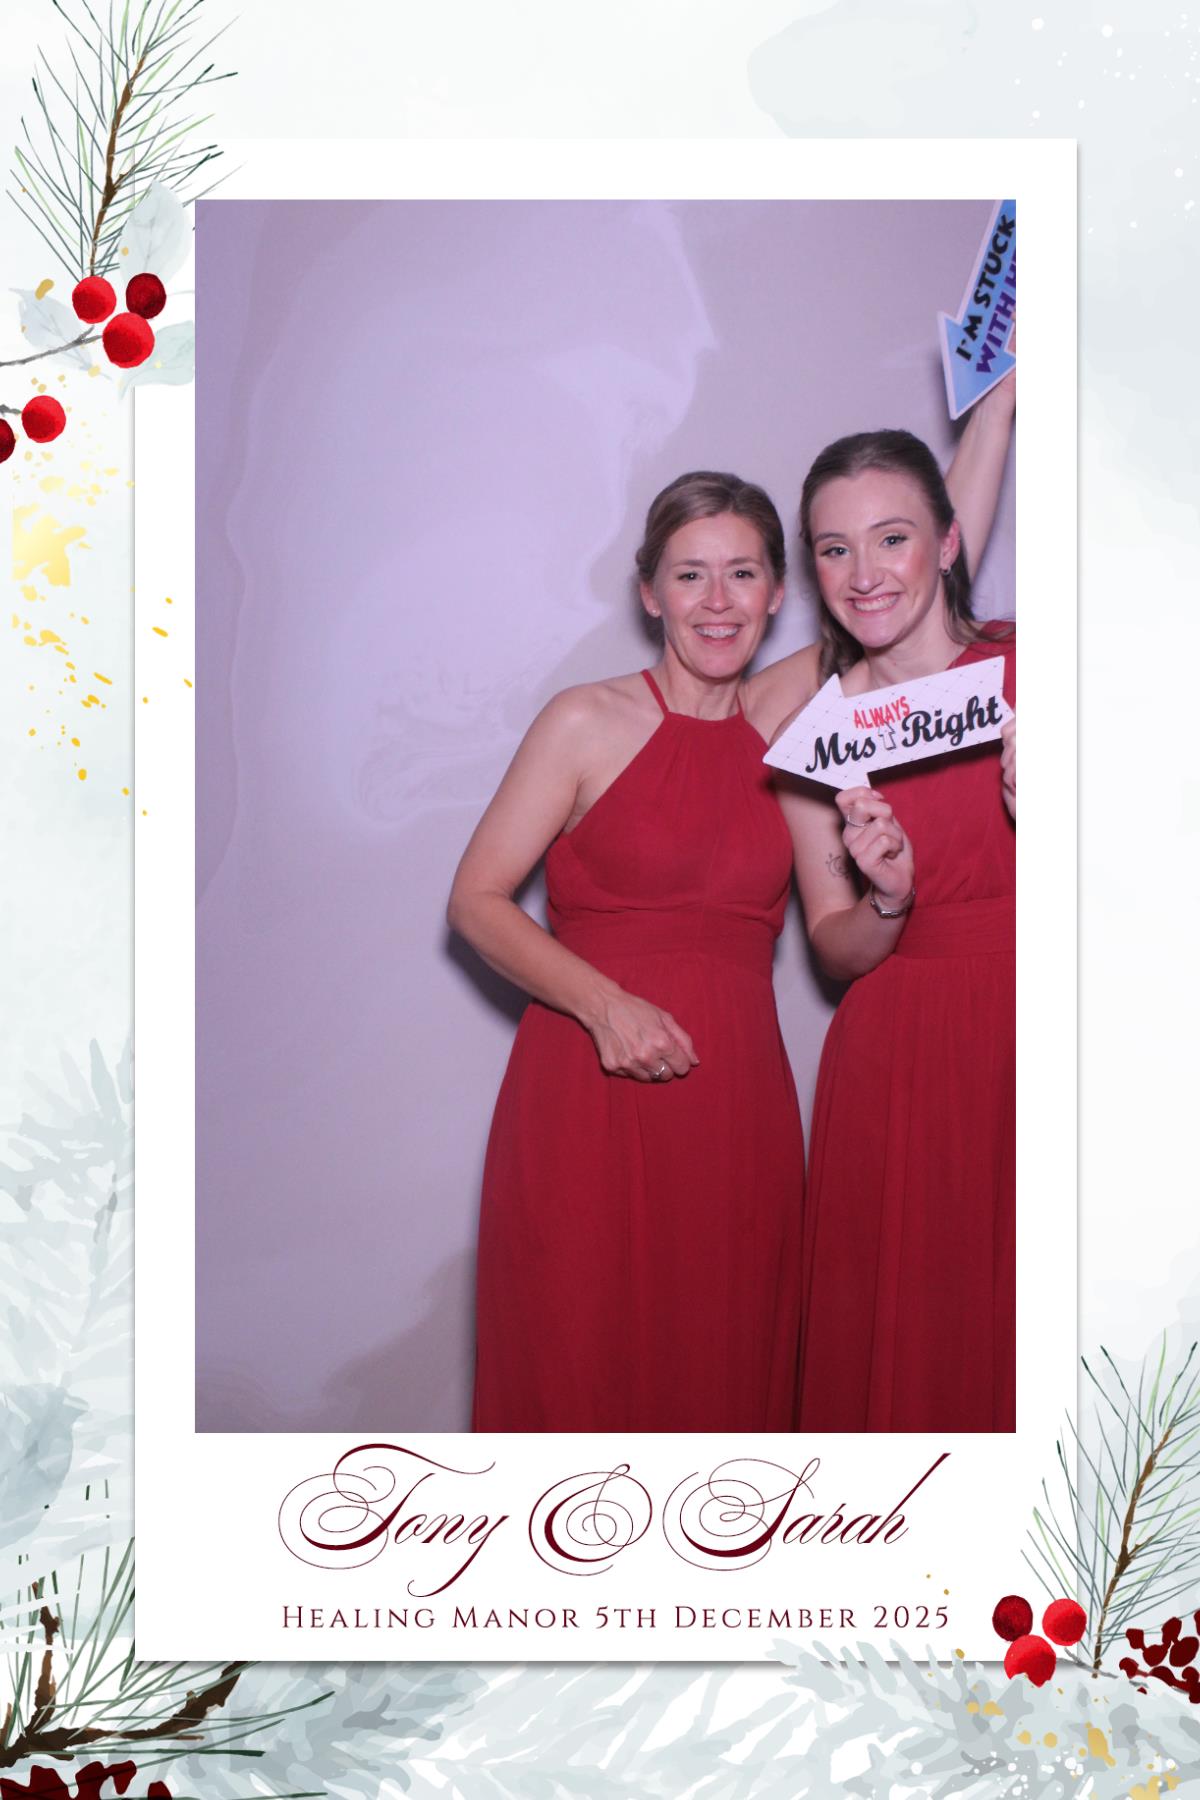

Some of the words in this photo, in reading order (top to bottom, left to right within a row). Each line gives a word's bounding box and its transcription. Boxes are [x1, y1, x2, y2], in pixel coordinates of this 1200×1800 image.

[955, 315, 983, 361] I'M
[973, 214, 1016, 309] STUCK
[975, 291, 1016, 373] WITH
[805, 732, 877, 773] Mrs
[901, 695, 1003, 747] Right
[853, 696, 911, 729] ALWAYS
